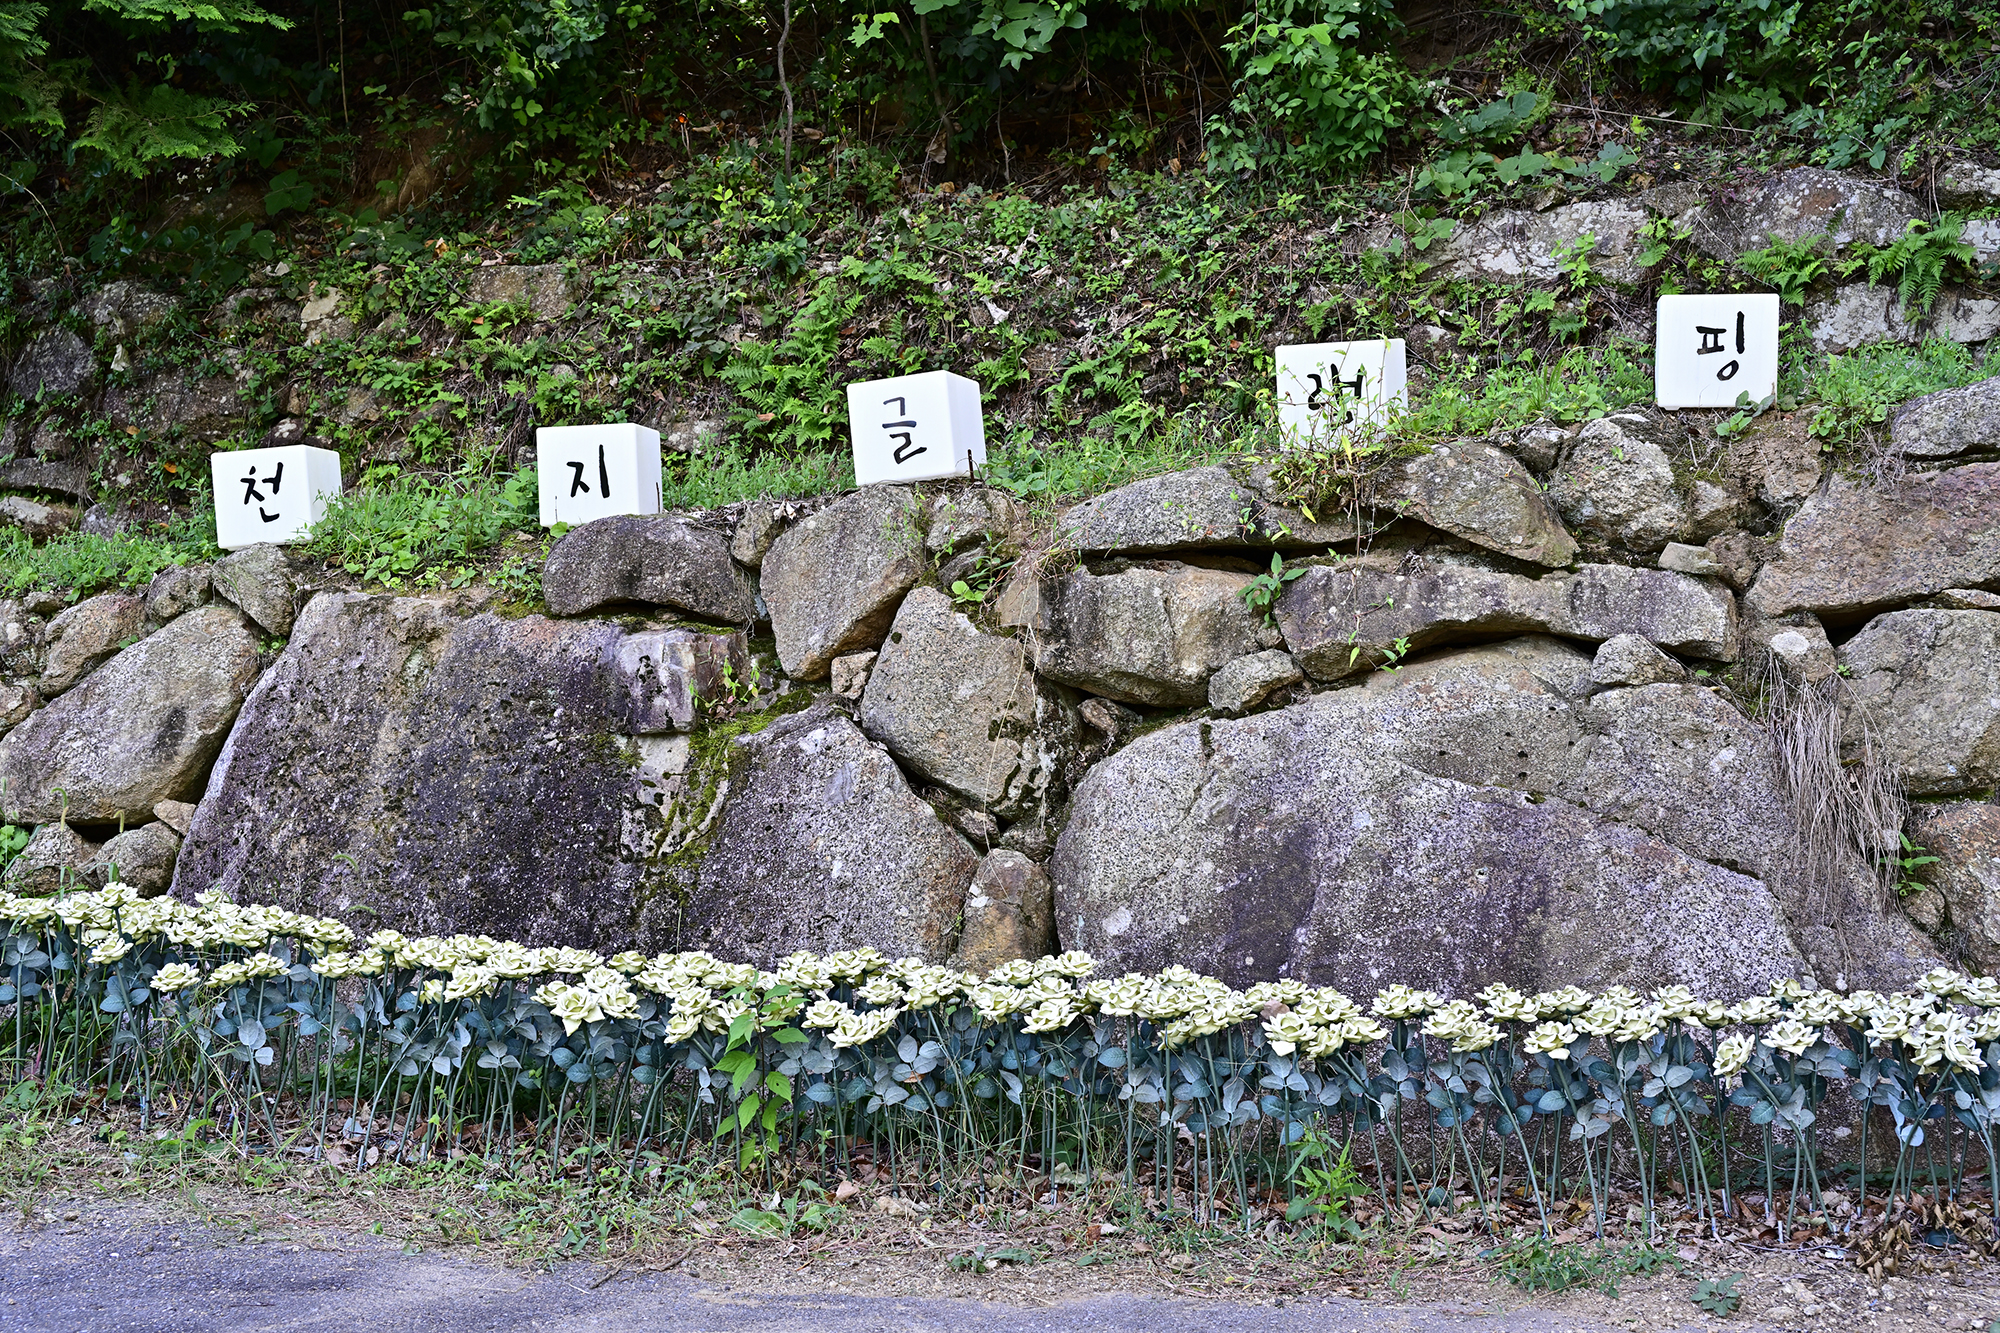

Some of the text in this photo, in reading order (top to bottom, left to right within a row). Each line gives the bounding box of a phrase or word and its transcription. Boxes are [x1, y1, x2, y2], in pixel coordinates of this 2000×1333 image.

[1695, 310, 1746, 381] 핑
[881, 396, 928, 465] 글
[239, 461, 284, 523] 천
[566, 445, 611, 499] 지
